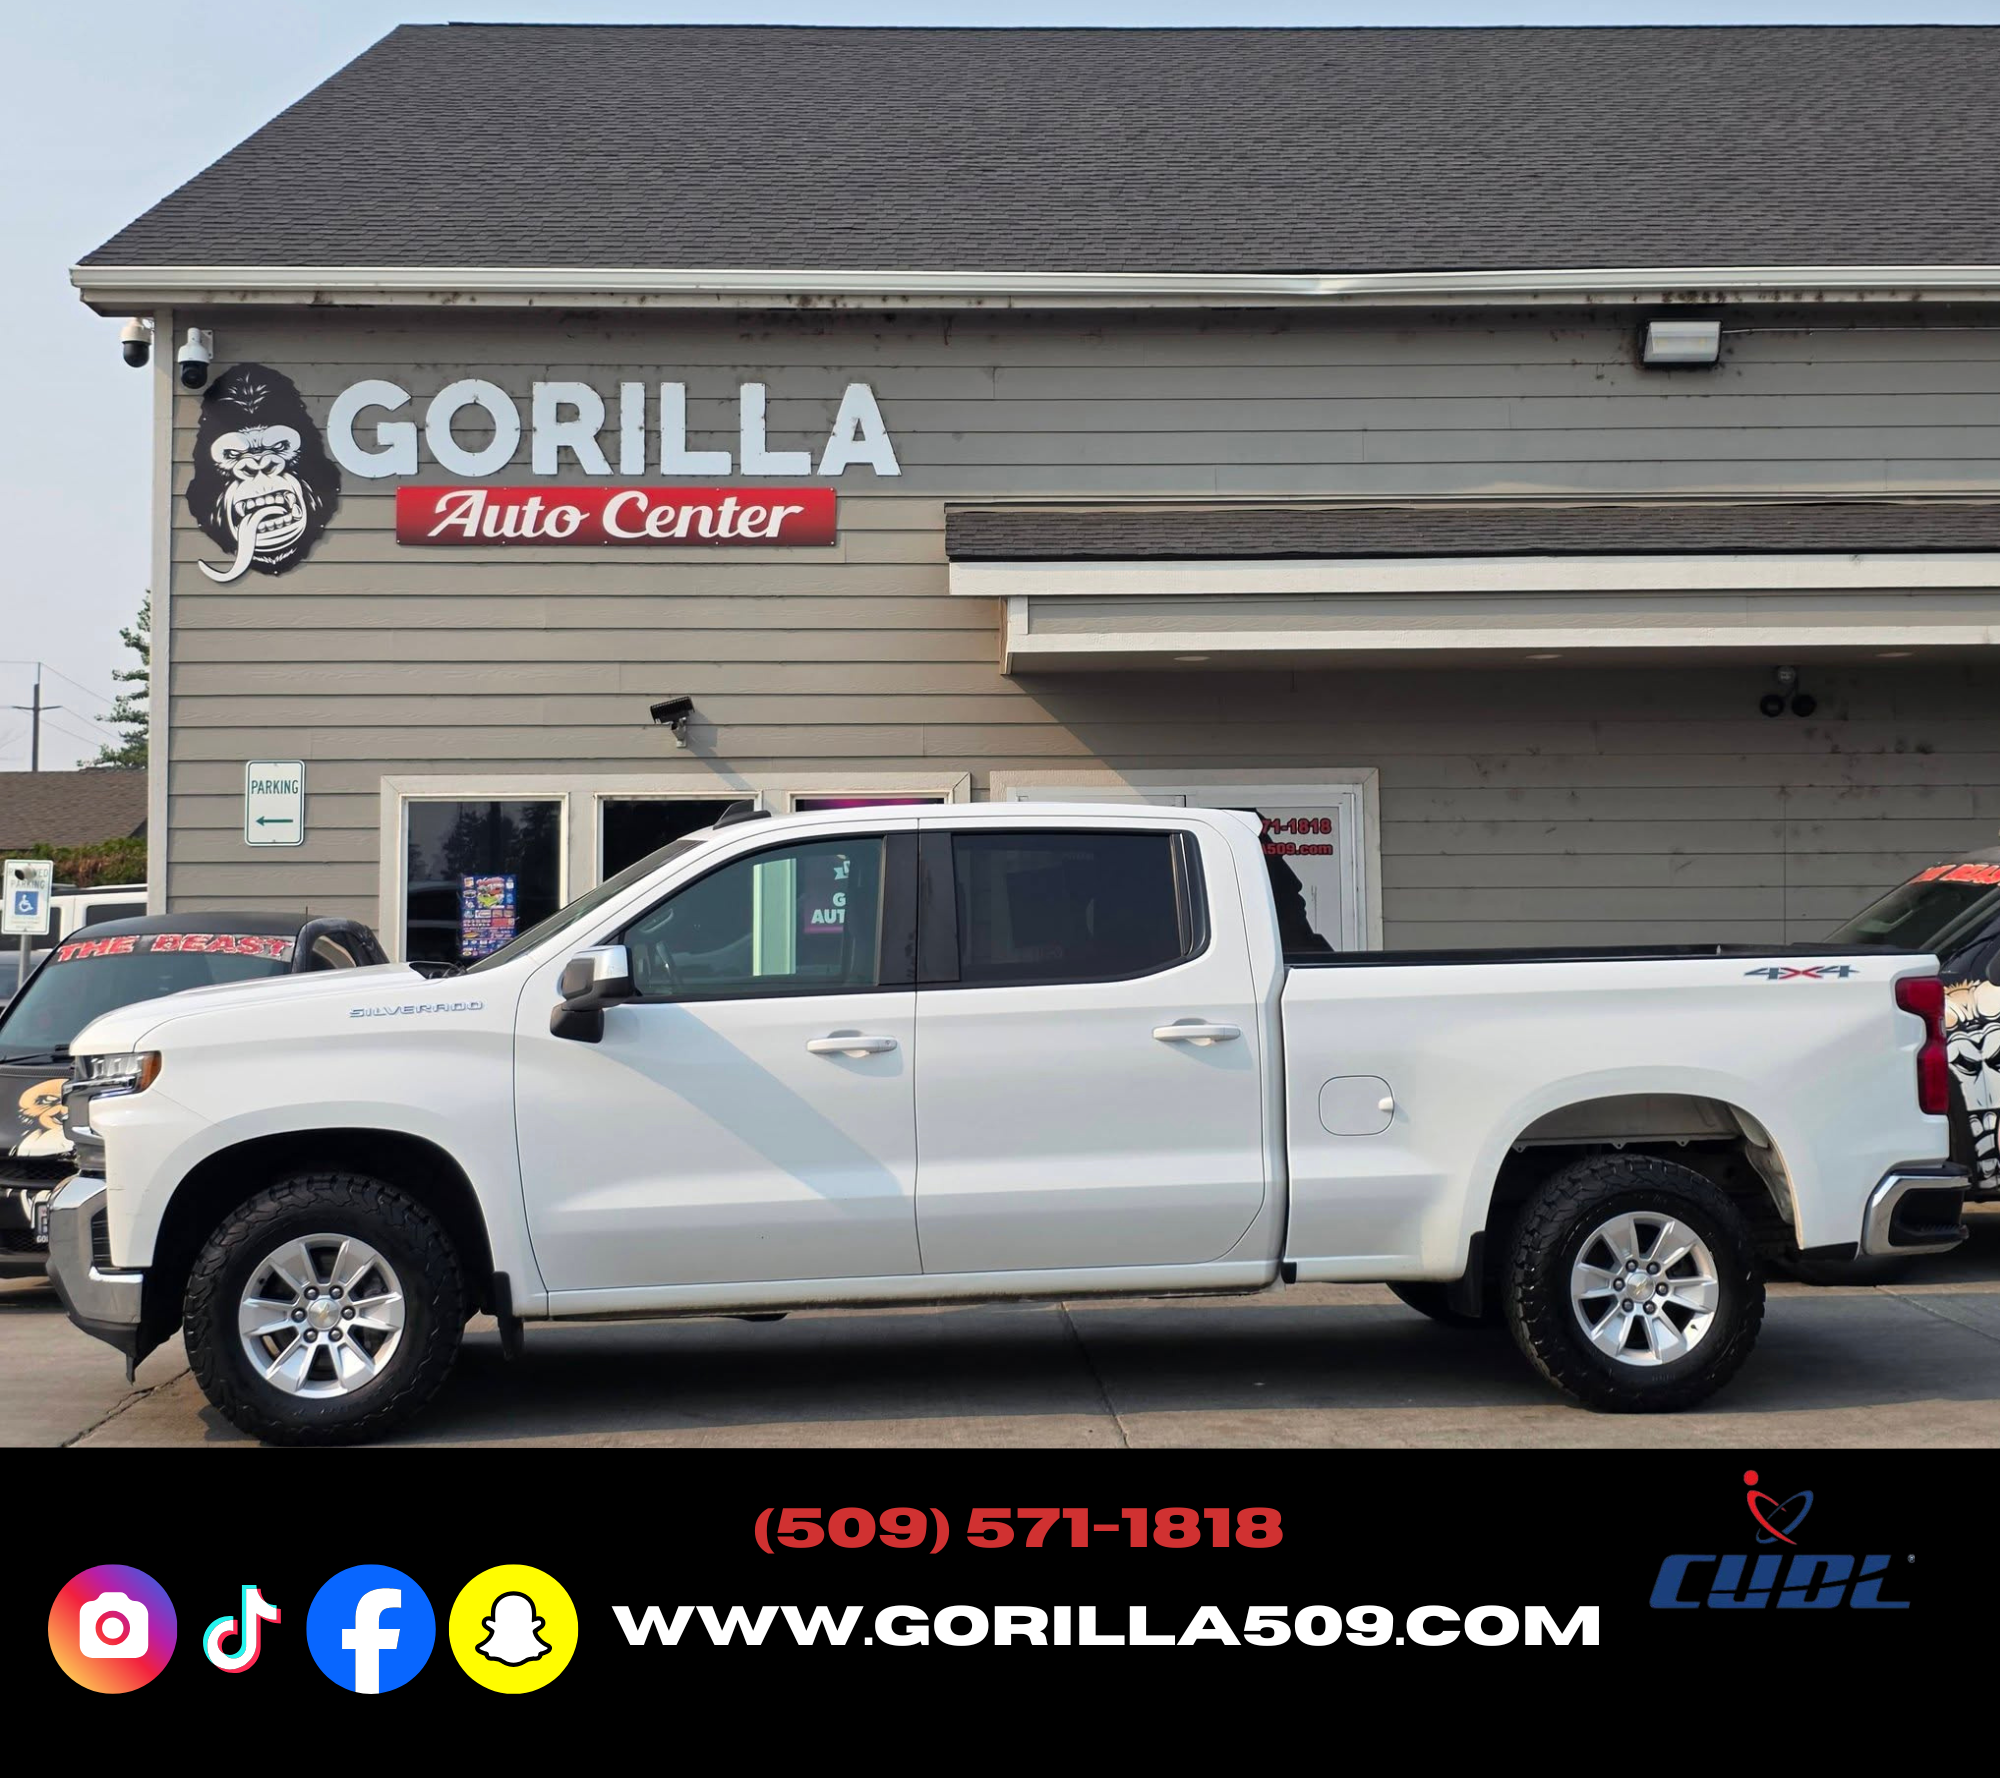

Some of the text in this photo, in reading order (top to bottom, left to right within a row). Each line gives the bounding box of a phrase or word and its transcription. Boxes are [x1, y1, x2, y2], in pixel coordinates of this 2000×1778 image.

[327, 379, 901, 478] GORILLA
[428, 490, 804, 540] Auto Center
[251, 779, 299, 795] PARKING
[57, 933, 294, 962] THE BEAST
[349, 1001, 485, 1018] SILVERADO
